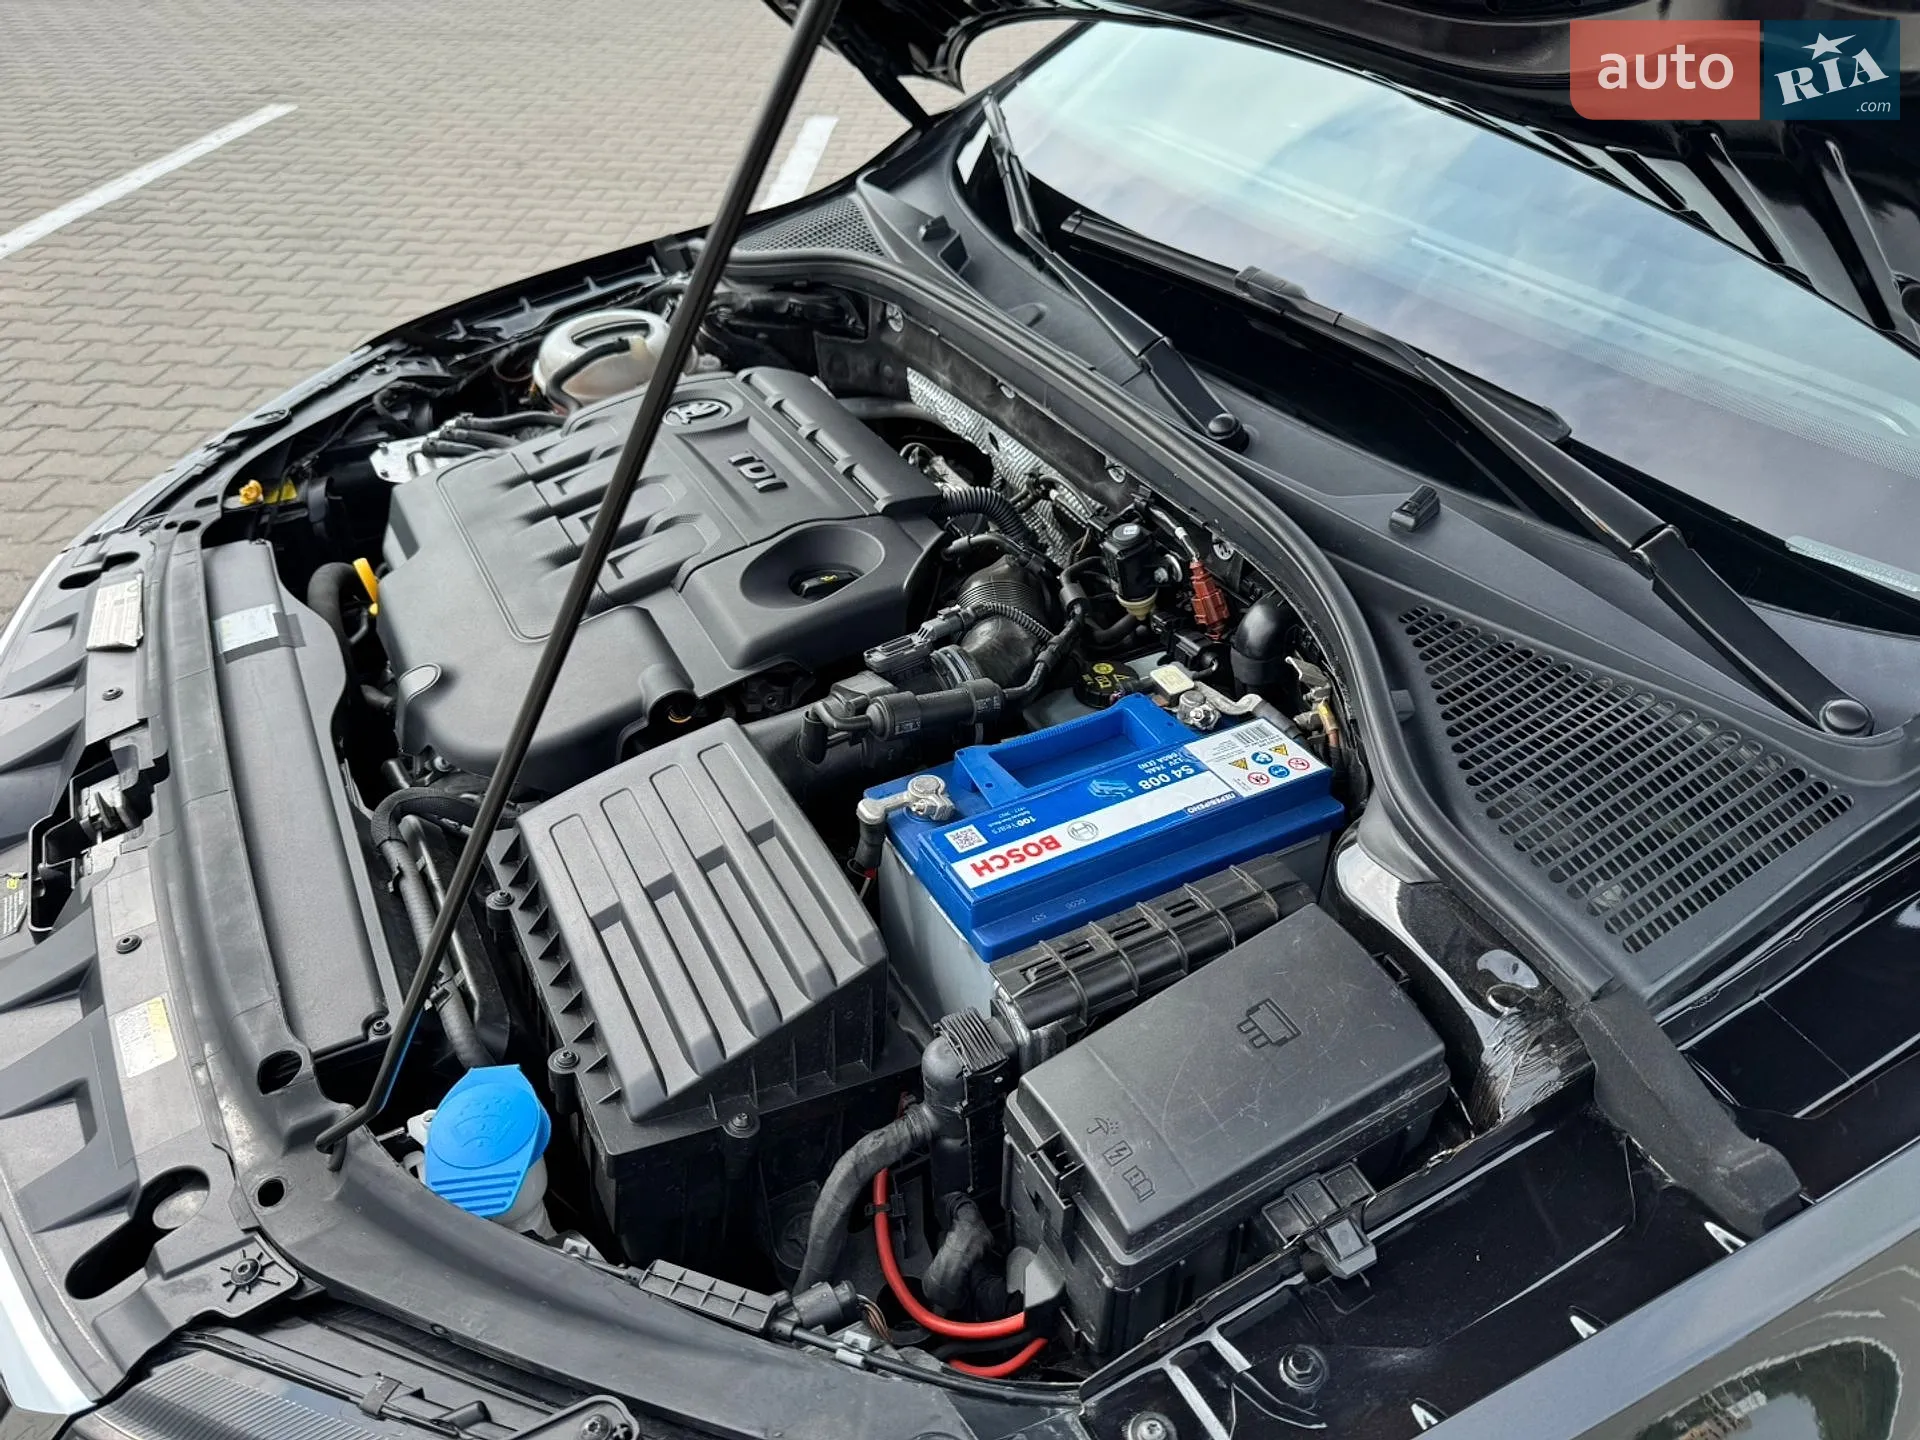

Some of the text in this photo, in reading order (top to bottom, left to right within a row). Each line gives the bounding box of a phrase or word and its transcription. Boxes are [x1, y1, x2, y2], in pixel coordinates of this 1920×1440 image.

[728, 449, 788, 493] TDI
[1137, 765, 1196, 790] S4 008
[970, 834, 1063, 877] BOSCH
